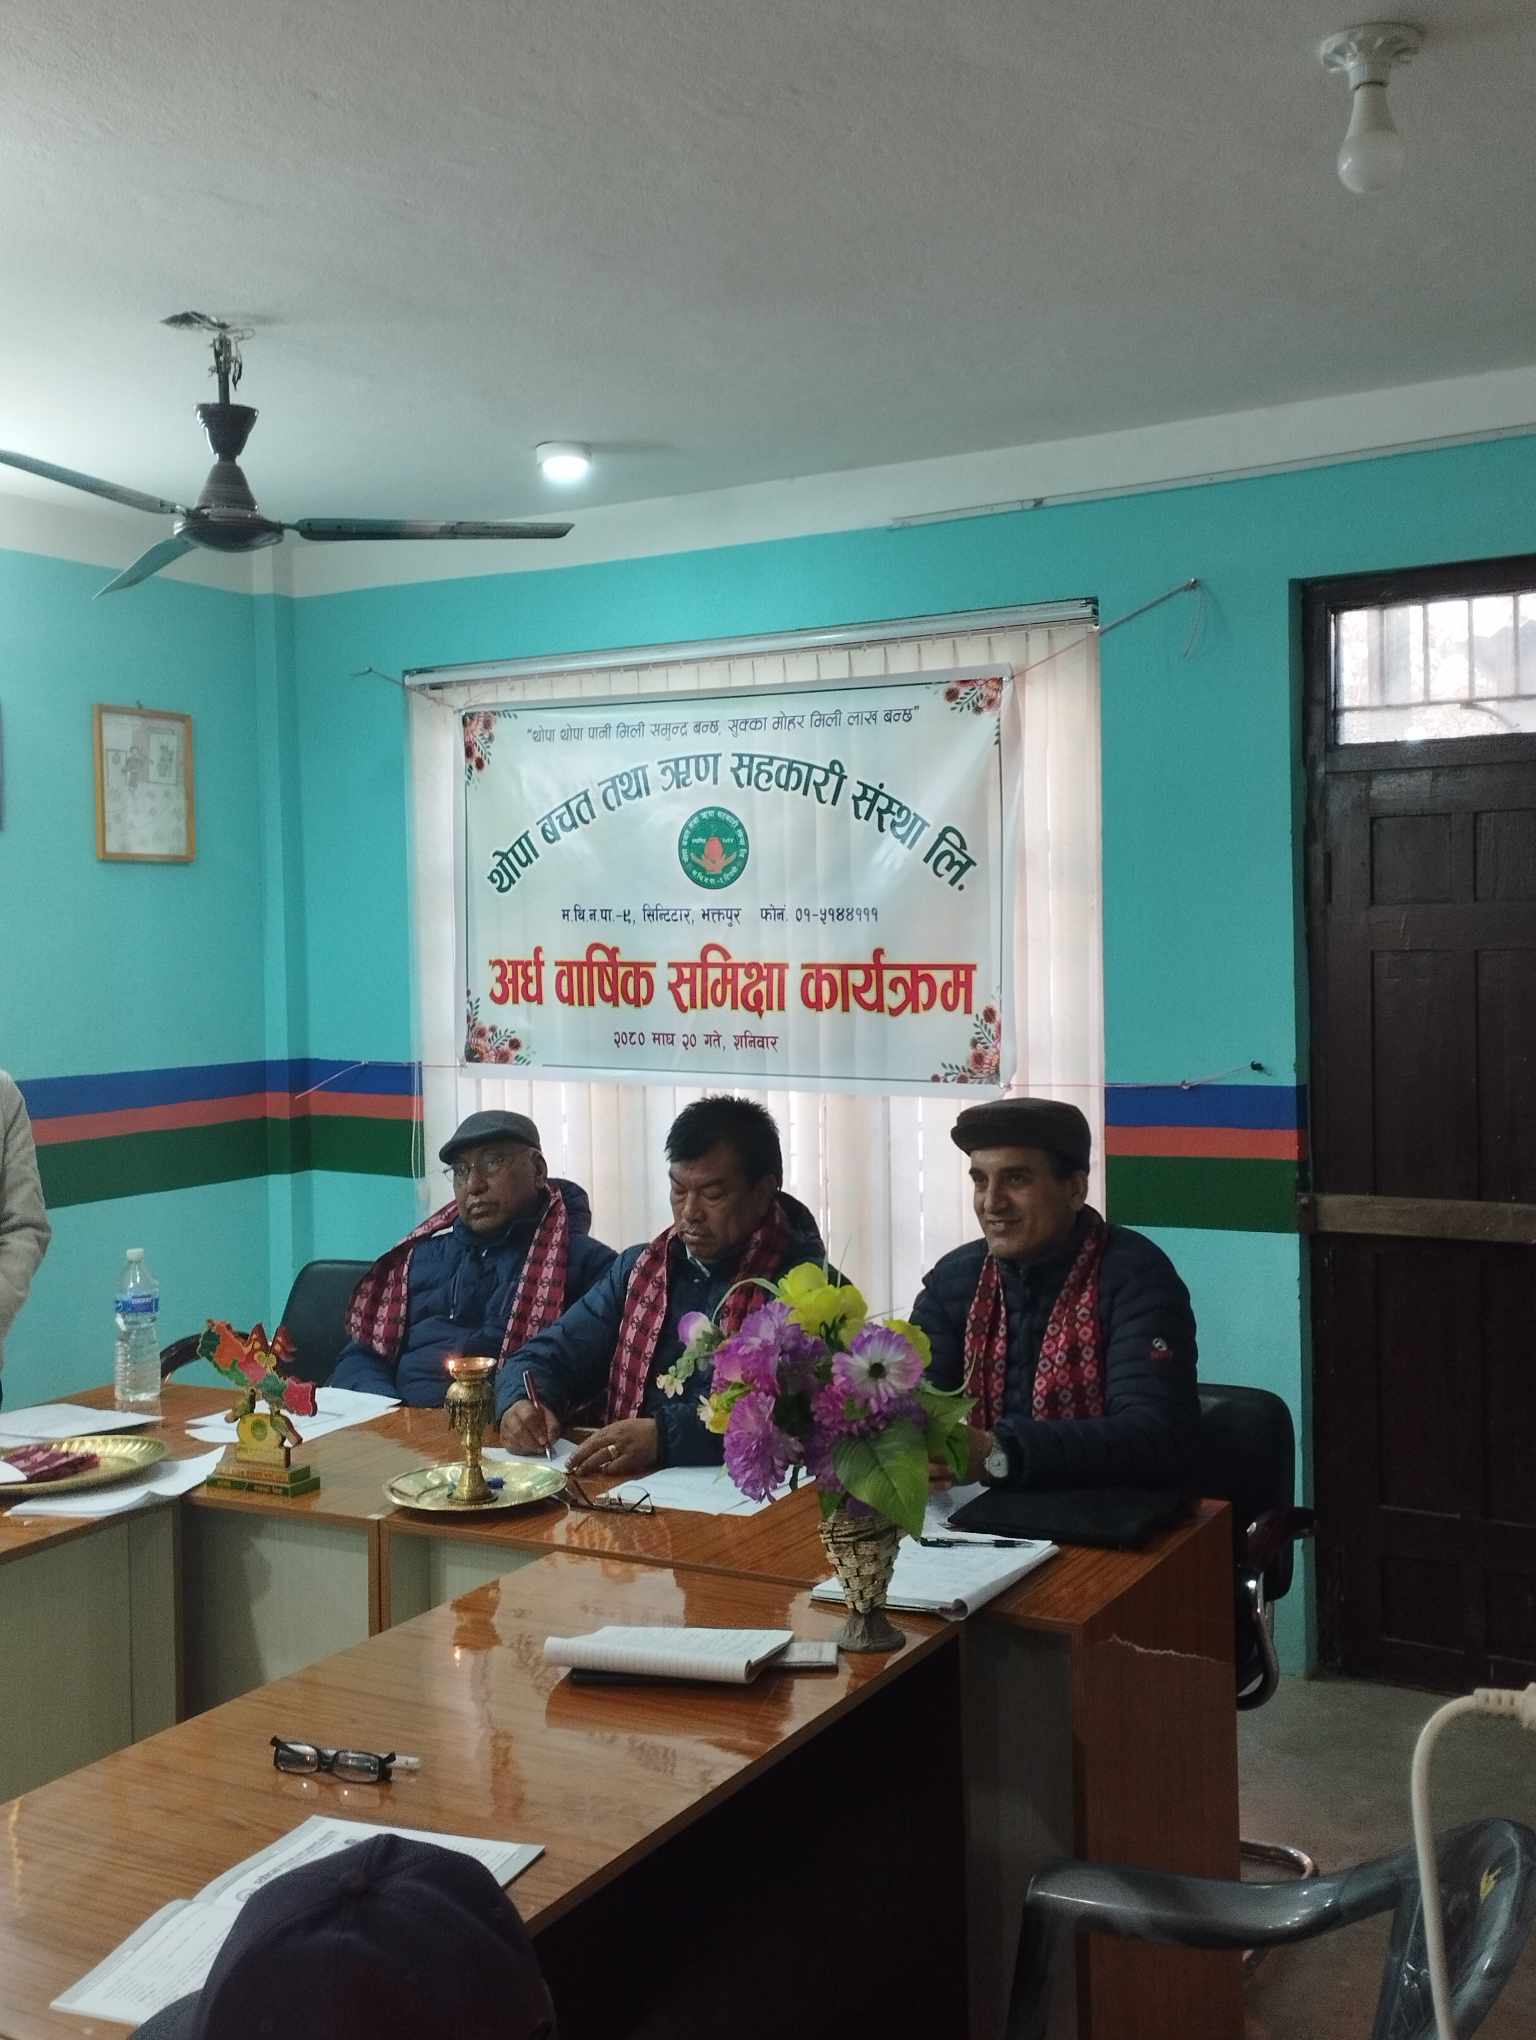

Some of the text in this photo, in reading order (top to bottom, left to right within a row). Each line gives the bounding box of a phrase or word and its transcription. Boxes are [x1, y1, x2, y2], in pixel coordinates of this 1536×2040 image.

[847, 709, 878, 727] लाख
[487, 752, 978, 893] थोपा बचत तथा ऋण सहकारी संस्था लि.
[701, 907, 743, 928] भक्तपुर
[488, 942, 977, 1020] अर्ध वार्षिक समिक्षा कार्यक्रम
[613, 1031, 646, 1048] २०८०
[651, 1032, 675, 1047] माघ
[682, 1033, 698, 1051] २०
[733, 1030, 779, 1052] शनिवार
